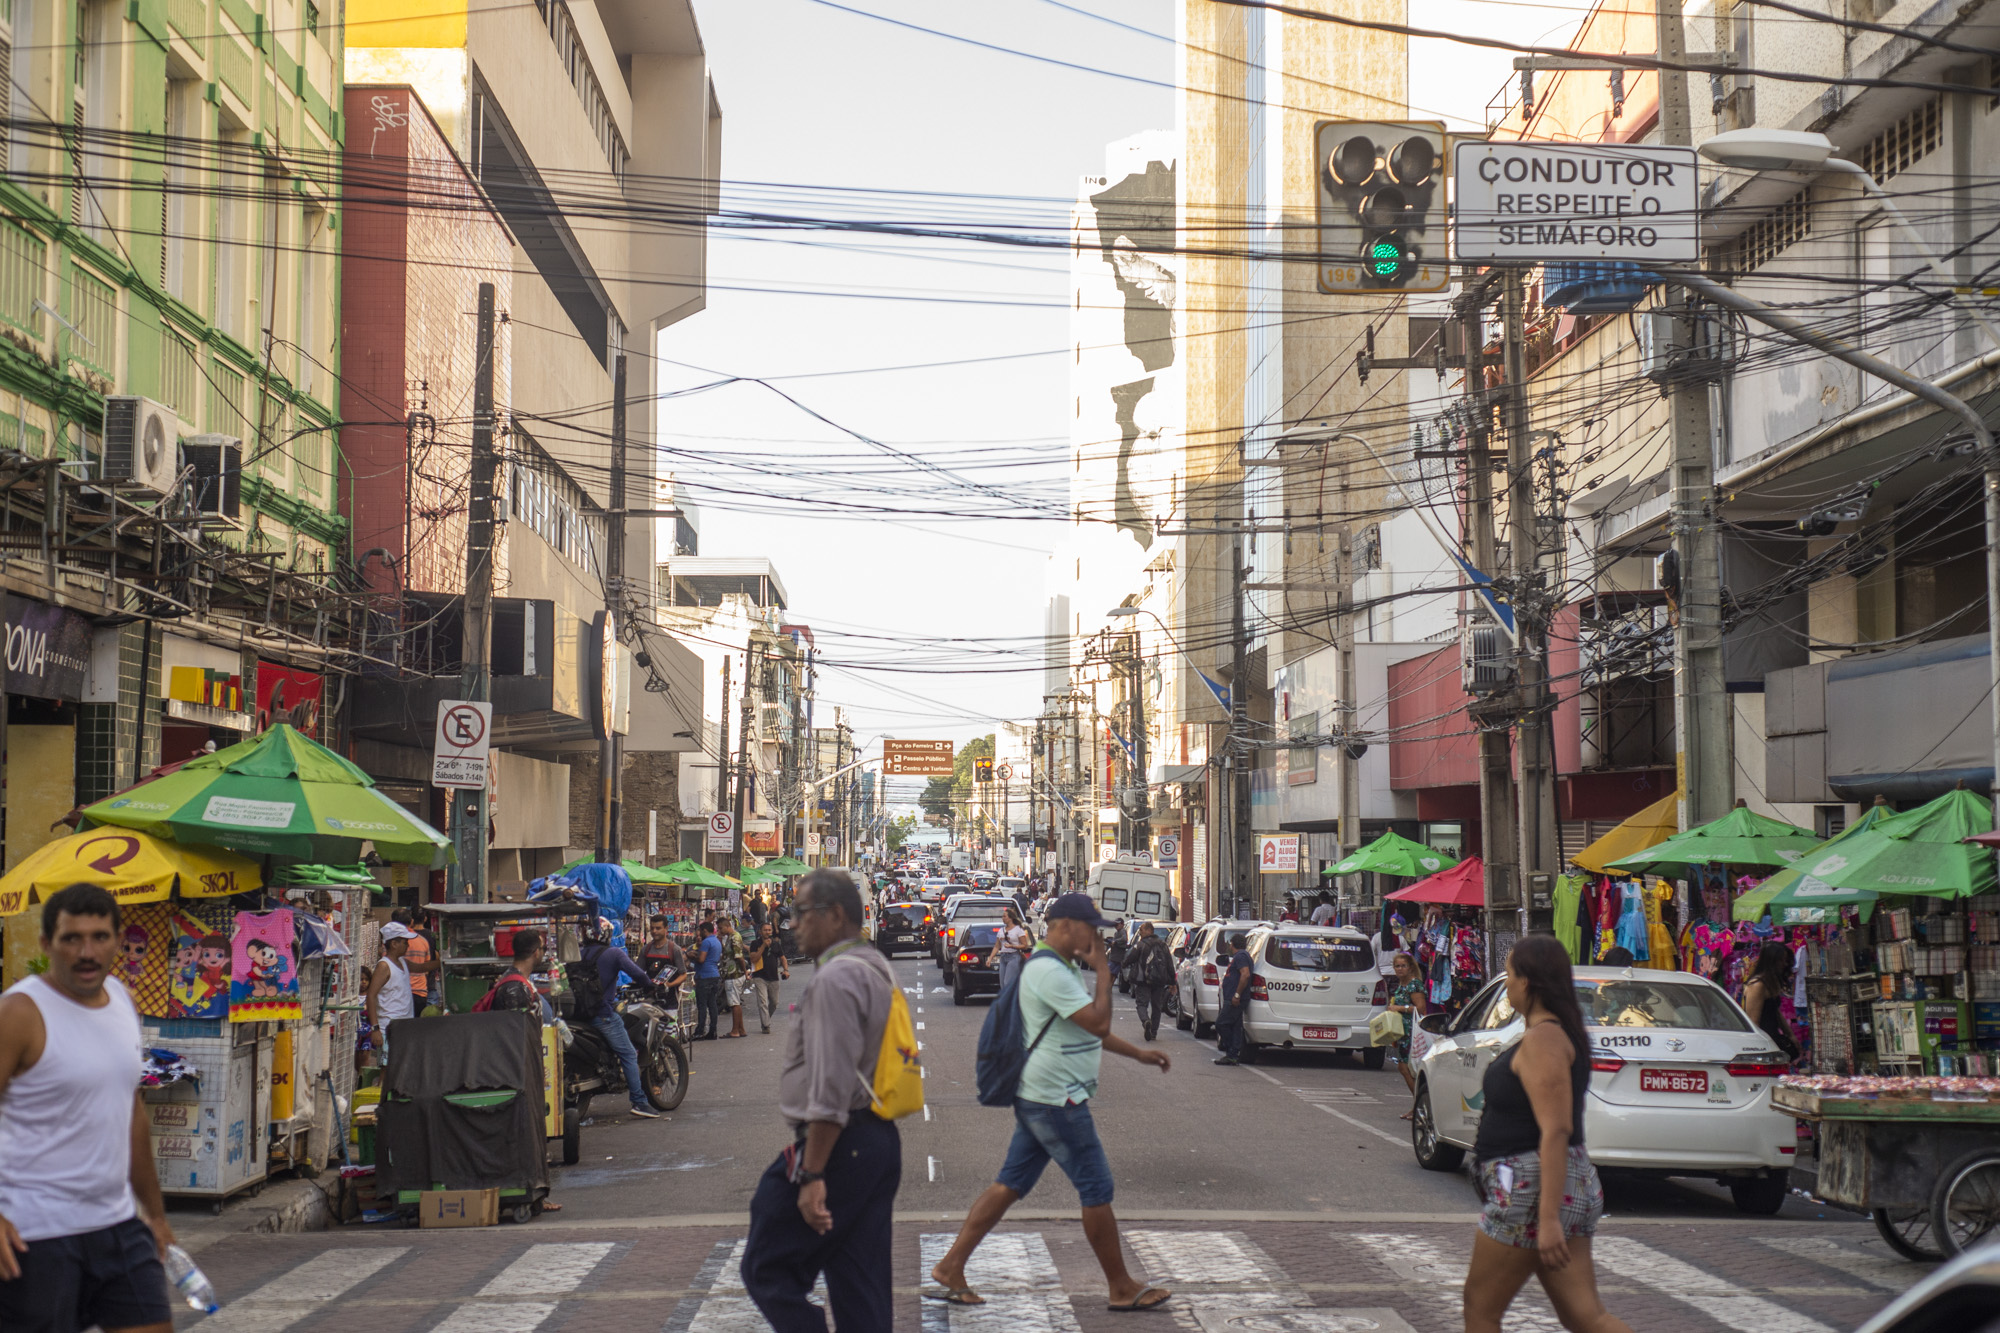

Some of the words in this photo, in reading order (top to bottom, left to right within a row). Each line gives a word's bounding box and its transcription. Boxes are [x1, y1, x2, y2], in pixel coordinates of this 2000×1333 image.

[1478, 156, 1676, 187] CONDUTOR
[1497, 193, 1632, 217] RESPEITE
[1641, 196, 1661, 217] O
[1498, 219, 1658, 247] SEMÁFORO
[1327, 268, 1356, 283] 196
[1421, 267, 1430, 281] A
[434, 771, 464, 780] Sábados
[465, 773, 484, 781] 7-14h
[1164, 843, 1171, 852] E
[1279, 838, 1298, 846] VENDE
[1278, 847, 1297, 855] ALUGA
[199, 871, 239, 894] SKOL
[1877, 874, 1910, 884] AQUI
[1910, 876, 1937, 886] TEM
[118, 883, 158, 897] REDONDO.
[1267, 981, 1310, 992] 002097
[1600, 1035, 1652, 1048] 013110
[157, 1107, 186, 1118] 1212
[161, 1138, 190, 1149] 1212
